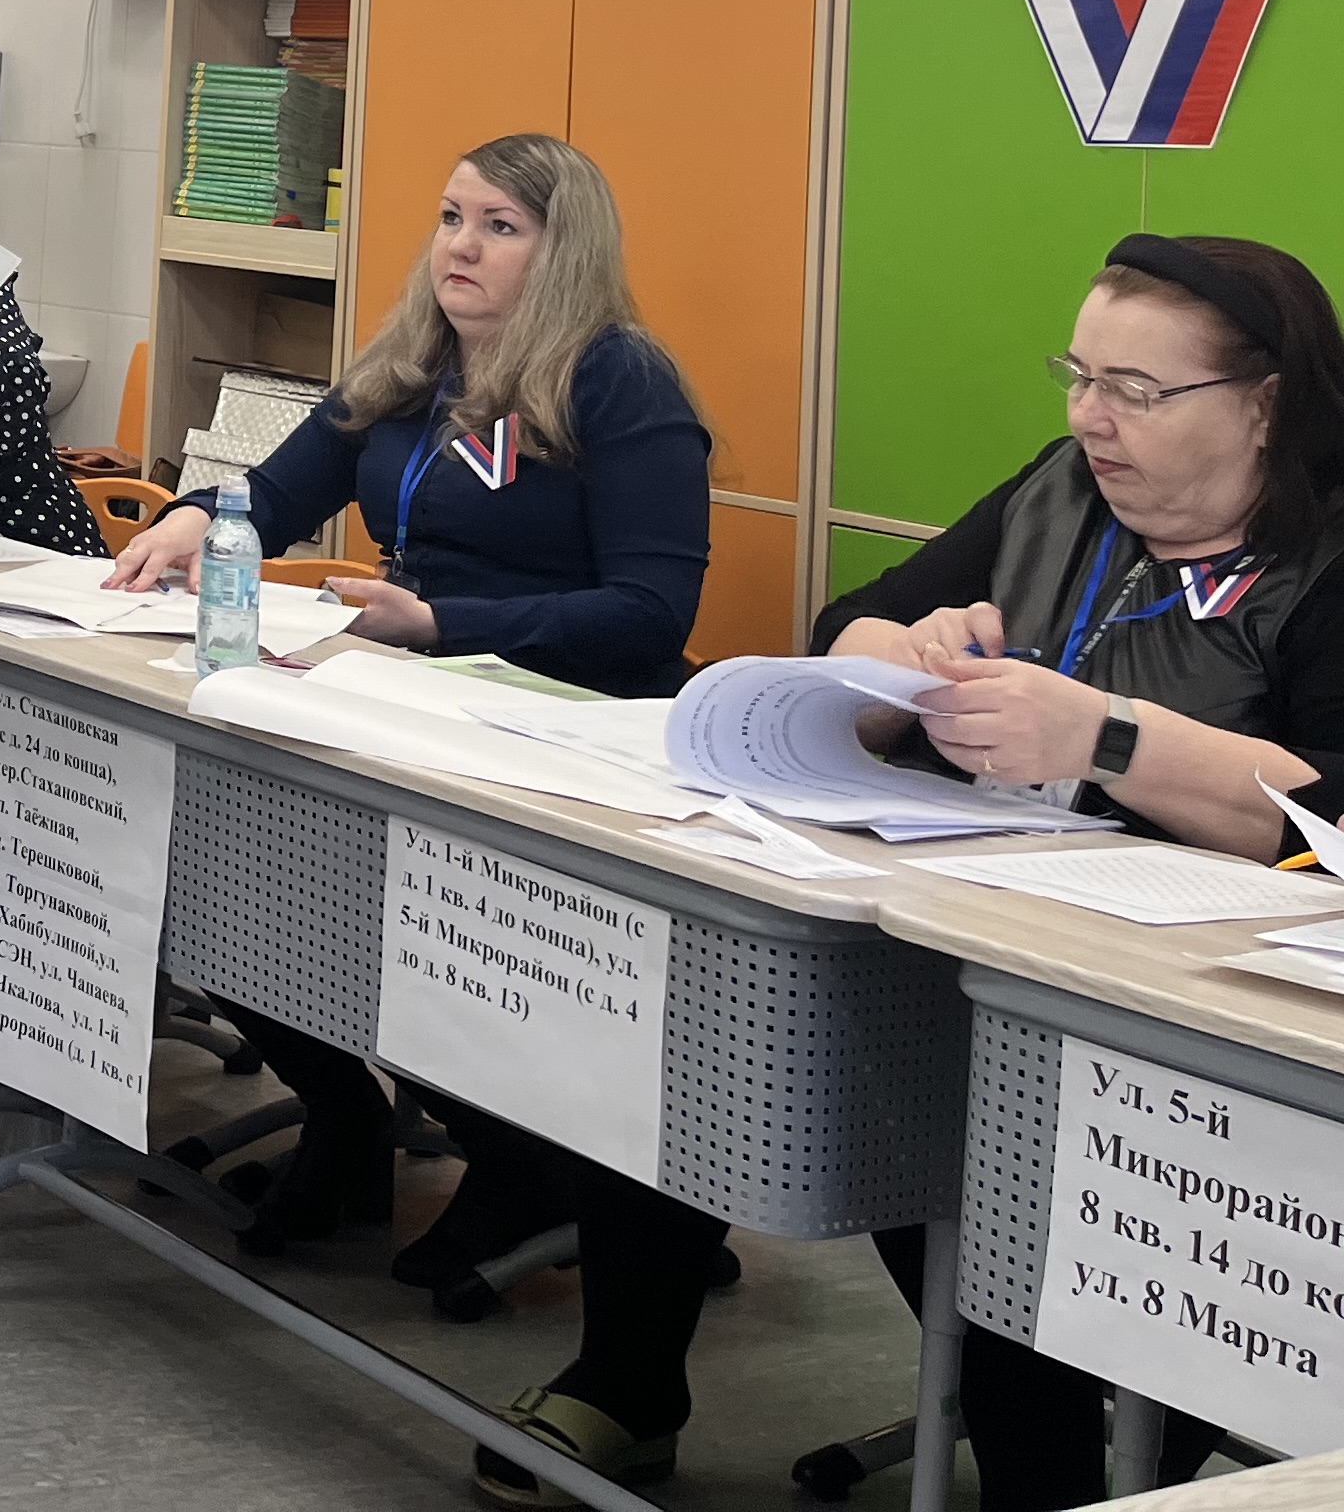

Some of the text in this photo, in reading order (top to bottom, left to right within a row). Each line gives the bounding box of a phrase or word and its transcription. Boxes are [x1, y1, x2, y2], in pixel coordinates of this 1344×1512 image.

[20, 695, 119, 747] Стахановская
[9, 732, 21, 751] д.
[26, 734, 40, 756] 24
[43, 745, 60, 763] до
[64, 752, 117, 787] конца),
[14, 799, 79, 846] Таёжная,
[10, 835, 104, 894] Терешковой,
[405, 826, 646, 940] Ул. 1-й Микрорайон (с
[5, 872, 111, 937] Торгунаковой,
[400, 870, 639, 981] д. 1 кв. 4 до конца), ул.
[40, 960, 62, 982] ул.
[67, 966, 130, 1018] Чапаева,
[397, 947, 530, 1023] до д. 8 кв. 13)
[399, 904, 638, 1023] 5-й Микрорайон (с д. 4
[71, 1009, 93, 1033] ул.
[99, 1018, 120, 1045] 1-й
[68, 1040, 85, 1064] (д.
[90, 1050, 96, 1070] 1
[101, 1059, 123, 1084] кв.
[126, 1072, 133, 1089] с
[137, 1075, 143, 1095] 1
[1089, 1059, 1231, 1140] Ул. 5-й
[1079, 1189, 1290, 1296] 8 кв. 14 до
[1072, 1261, 1318, 1377] ул. 8 Марта
